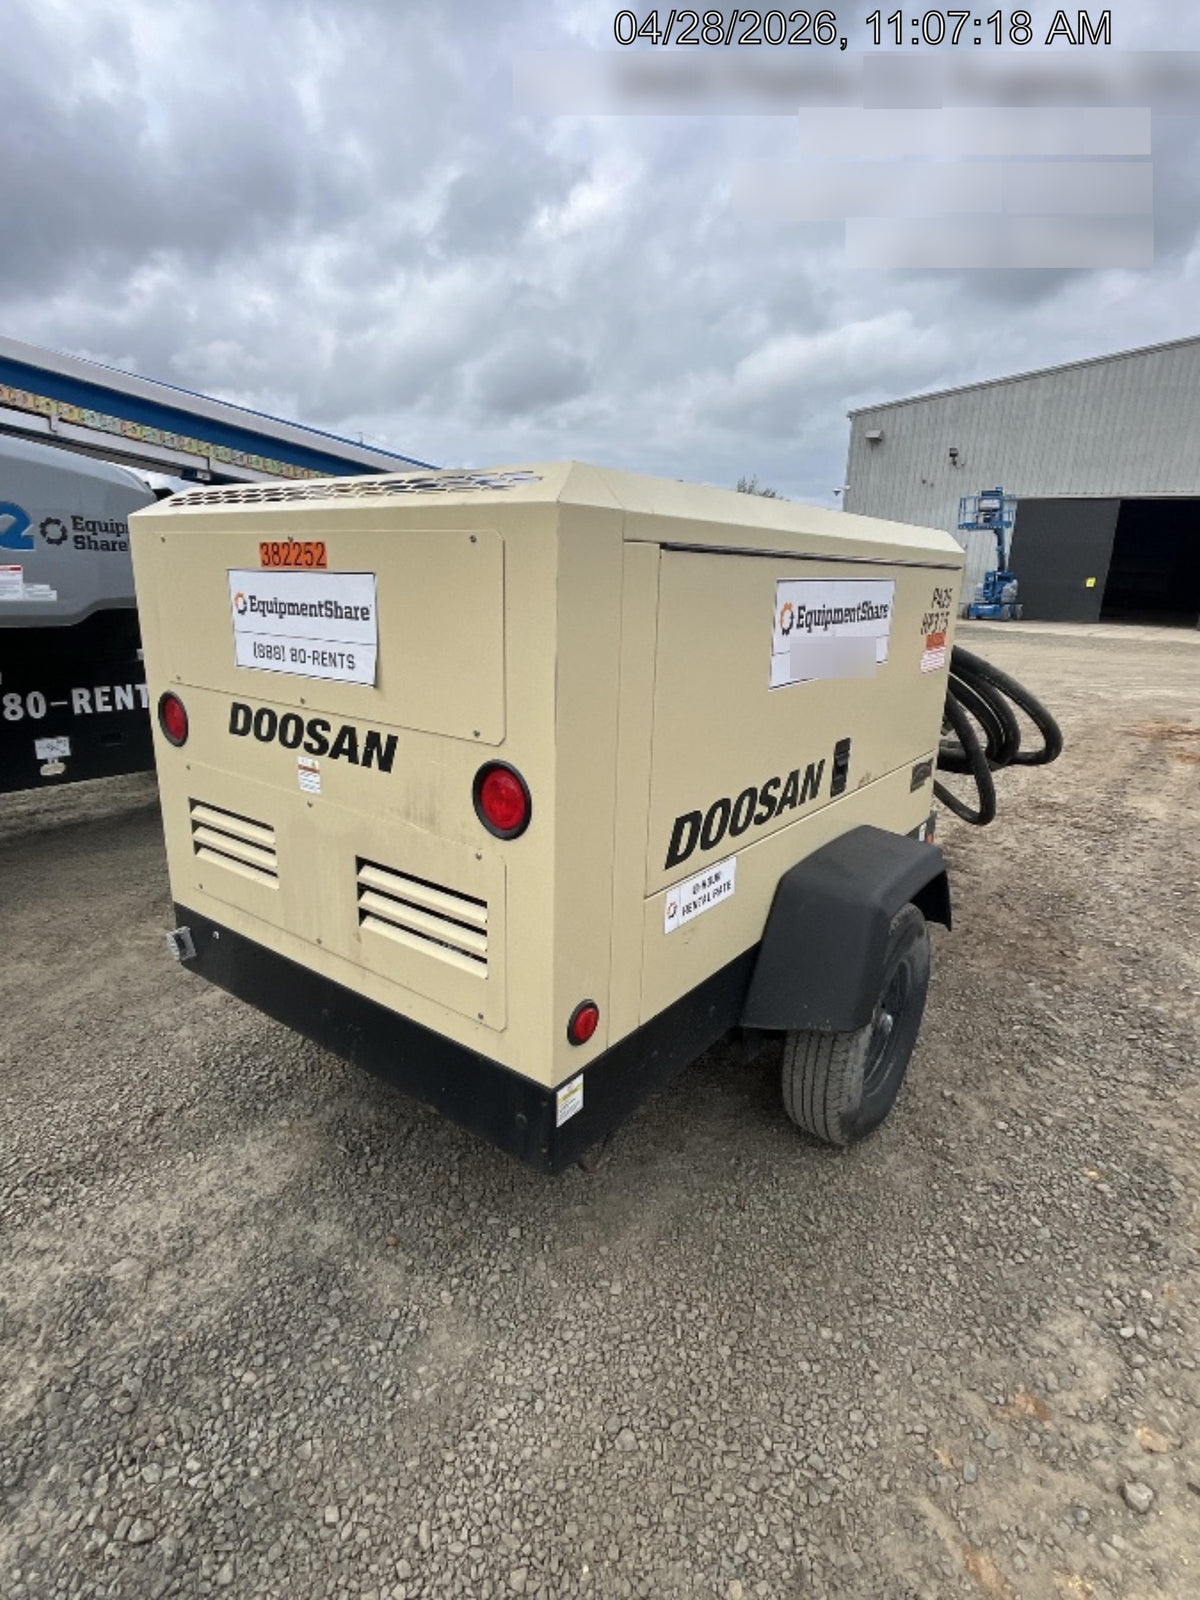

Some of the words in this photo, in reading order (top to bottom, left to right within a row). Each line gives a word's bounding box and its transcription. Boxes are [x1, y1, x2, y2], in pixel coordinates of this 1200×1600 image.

[73, 534, 128, 552] Share
[260, 541, 326, 567] 382252
[248, 595, 371, 621] EquipmentShare
[796, 600, 889, 633] EquipmentShare
[290, 648, 356, 670] 80-RENTS
[229, 702, 399, 773] DOOSAN
[664, 759, 825, 870] DOOSAN
